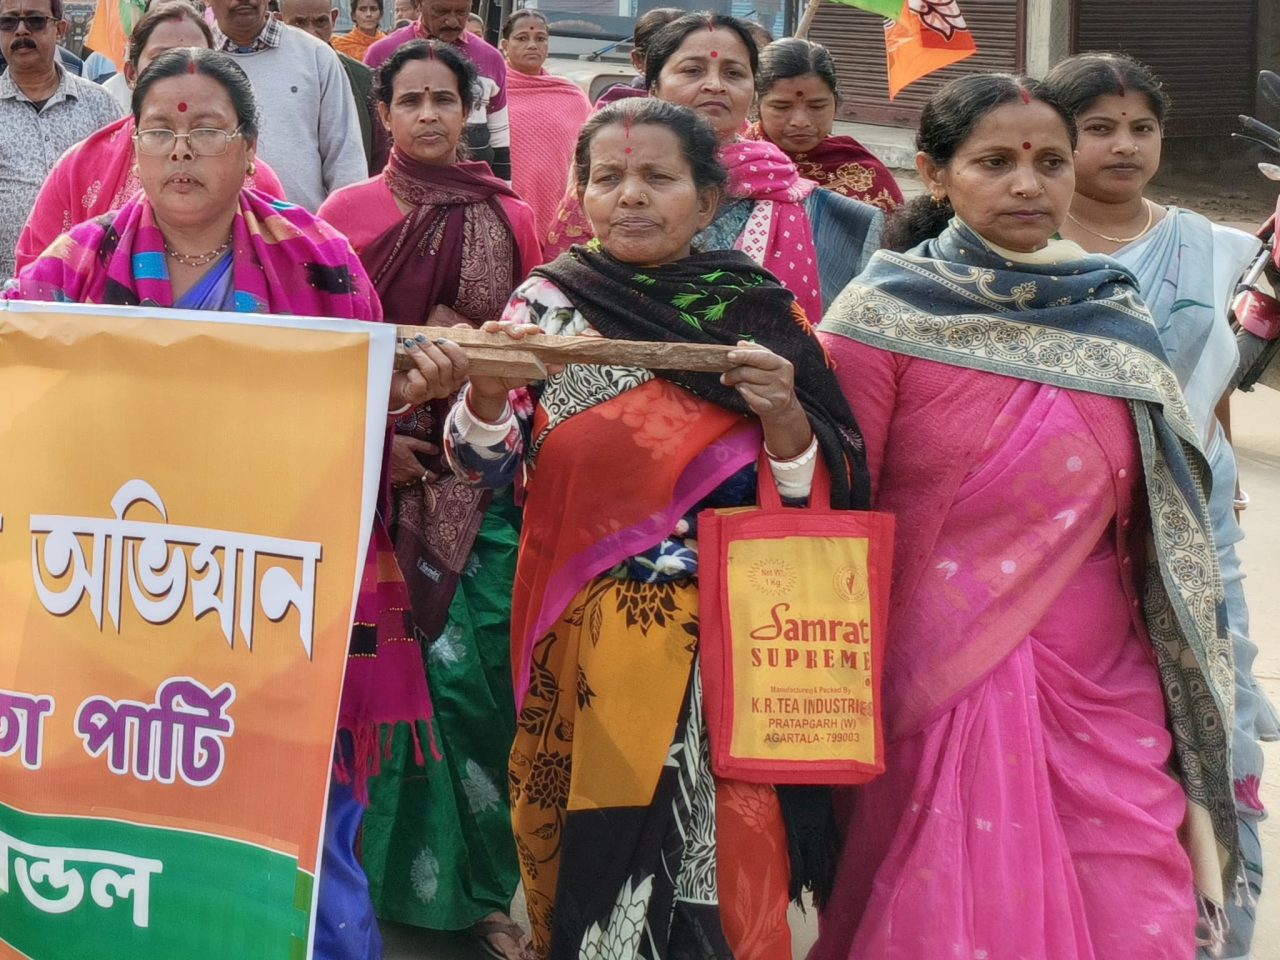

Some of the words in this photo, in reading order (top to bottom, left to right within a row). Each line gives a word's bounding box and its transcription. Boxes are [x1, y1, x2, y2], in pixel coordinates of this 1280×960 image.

[29, 479, 324, 658] অভিযান
[761, 568, 773, 577] Net
[750, 602, 869, 644] Samrat
[751, 648, 871, 670] SUPREME
[843, 686, 851, 695] By
[75, 678, 234, 785] পার্টি
[768, 718, 838, 729] PRATAPGARH
[841, 718, 856, 730] (W)
